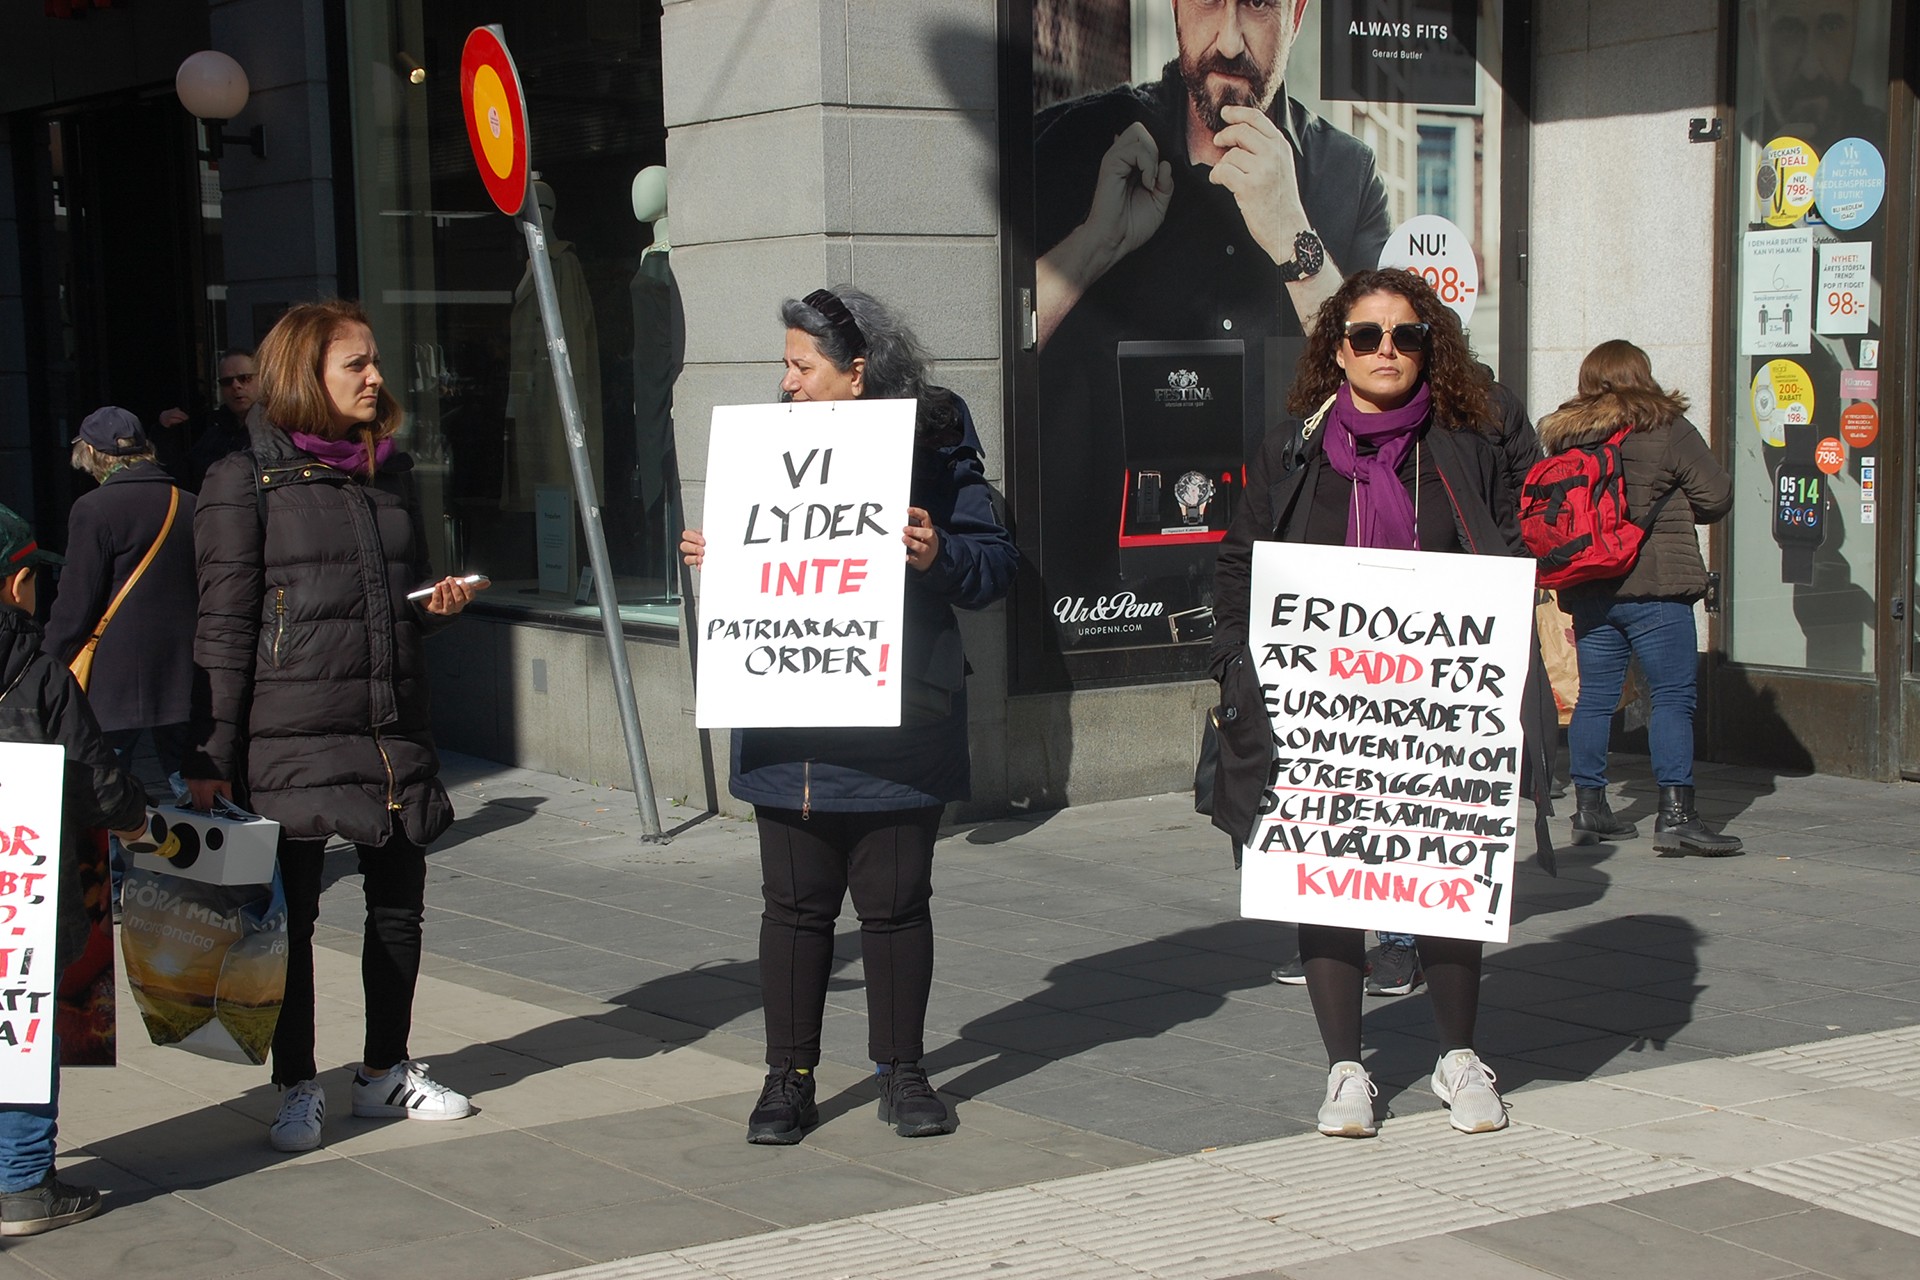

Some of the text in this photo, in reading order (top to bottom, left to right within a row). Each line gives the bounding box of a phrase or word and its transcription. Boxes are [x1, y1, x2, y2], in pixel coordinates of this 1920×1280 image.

[1348, 21, 1448, 40] ALWAYS FITS
[1372, 49, 1423, 60] Gerard Butler
[1769, 147, 1801, 158] VECKANS
[1780, 156, 1806, 166] DEAL
[1786, 184, 1813, 196] 798:-
[1793, 175, 1807, 183] NU!
[1410, 233, 1446, 256] NU!
[1831, 254, 1858, 263] NYHET!
[1406, 266, 1475, 303] 98:-
[1828, 291, 1865, 315] 98:-
[1154, 387, 1214, 401] FESTINA
[1779, 383, 1803, 394] 200:-
[1779, 393, 1802, 401] RABATT
[782, 448, 833, 489] VI
[1817, 451, 1843, 464] 798:-
[1780, 475, 1796, 494] 05
[1797, 477, 1819, 505] 14
[743, 502, 889, 545] LYDER
[760, 558, 868, 596] INTE
[1053, 591, 1164, 624] Ur&Penn
[707, 618, 884, 640] PATRIARKAT
[1078, 624, 1142, 636] UROPENN.COM
[1270, 593, 1496, 648] ERDOGAN
[745, 644, 890, 686] ORDER!
[1260, 683, 1506, 737] EUROPARÅDETS
[1469, 747, 1517, 775] OM
[1259, 825, 1510, 878] AV VÅLD MOT
[125, 878, 181, 916] GÖRA
[128, 916, 215, 952] morgondag
